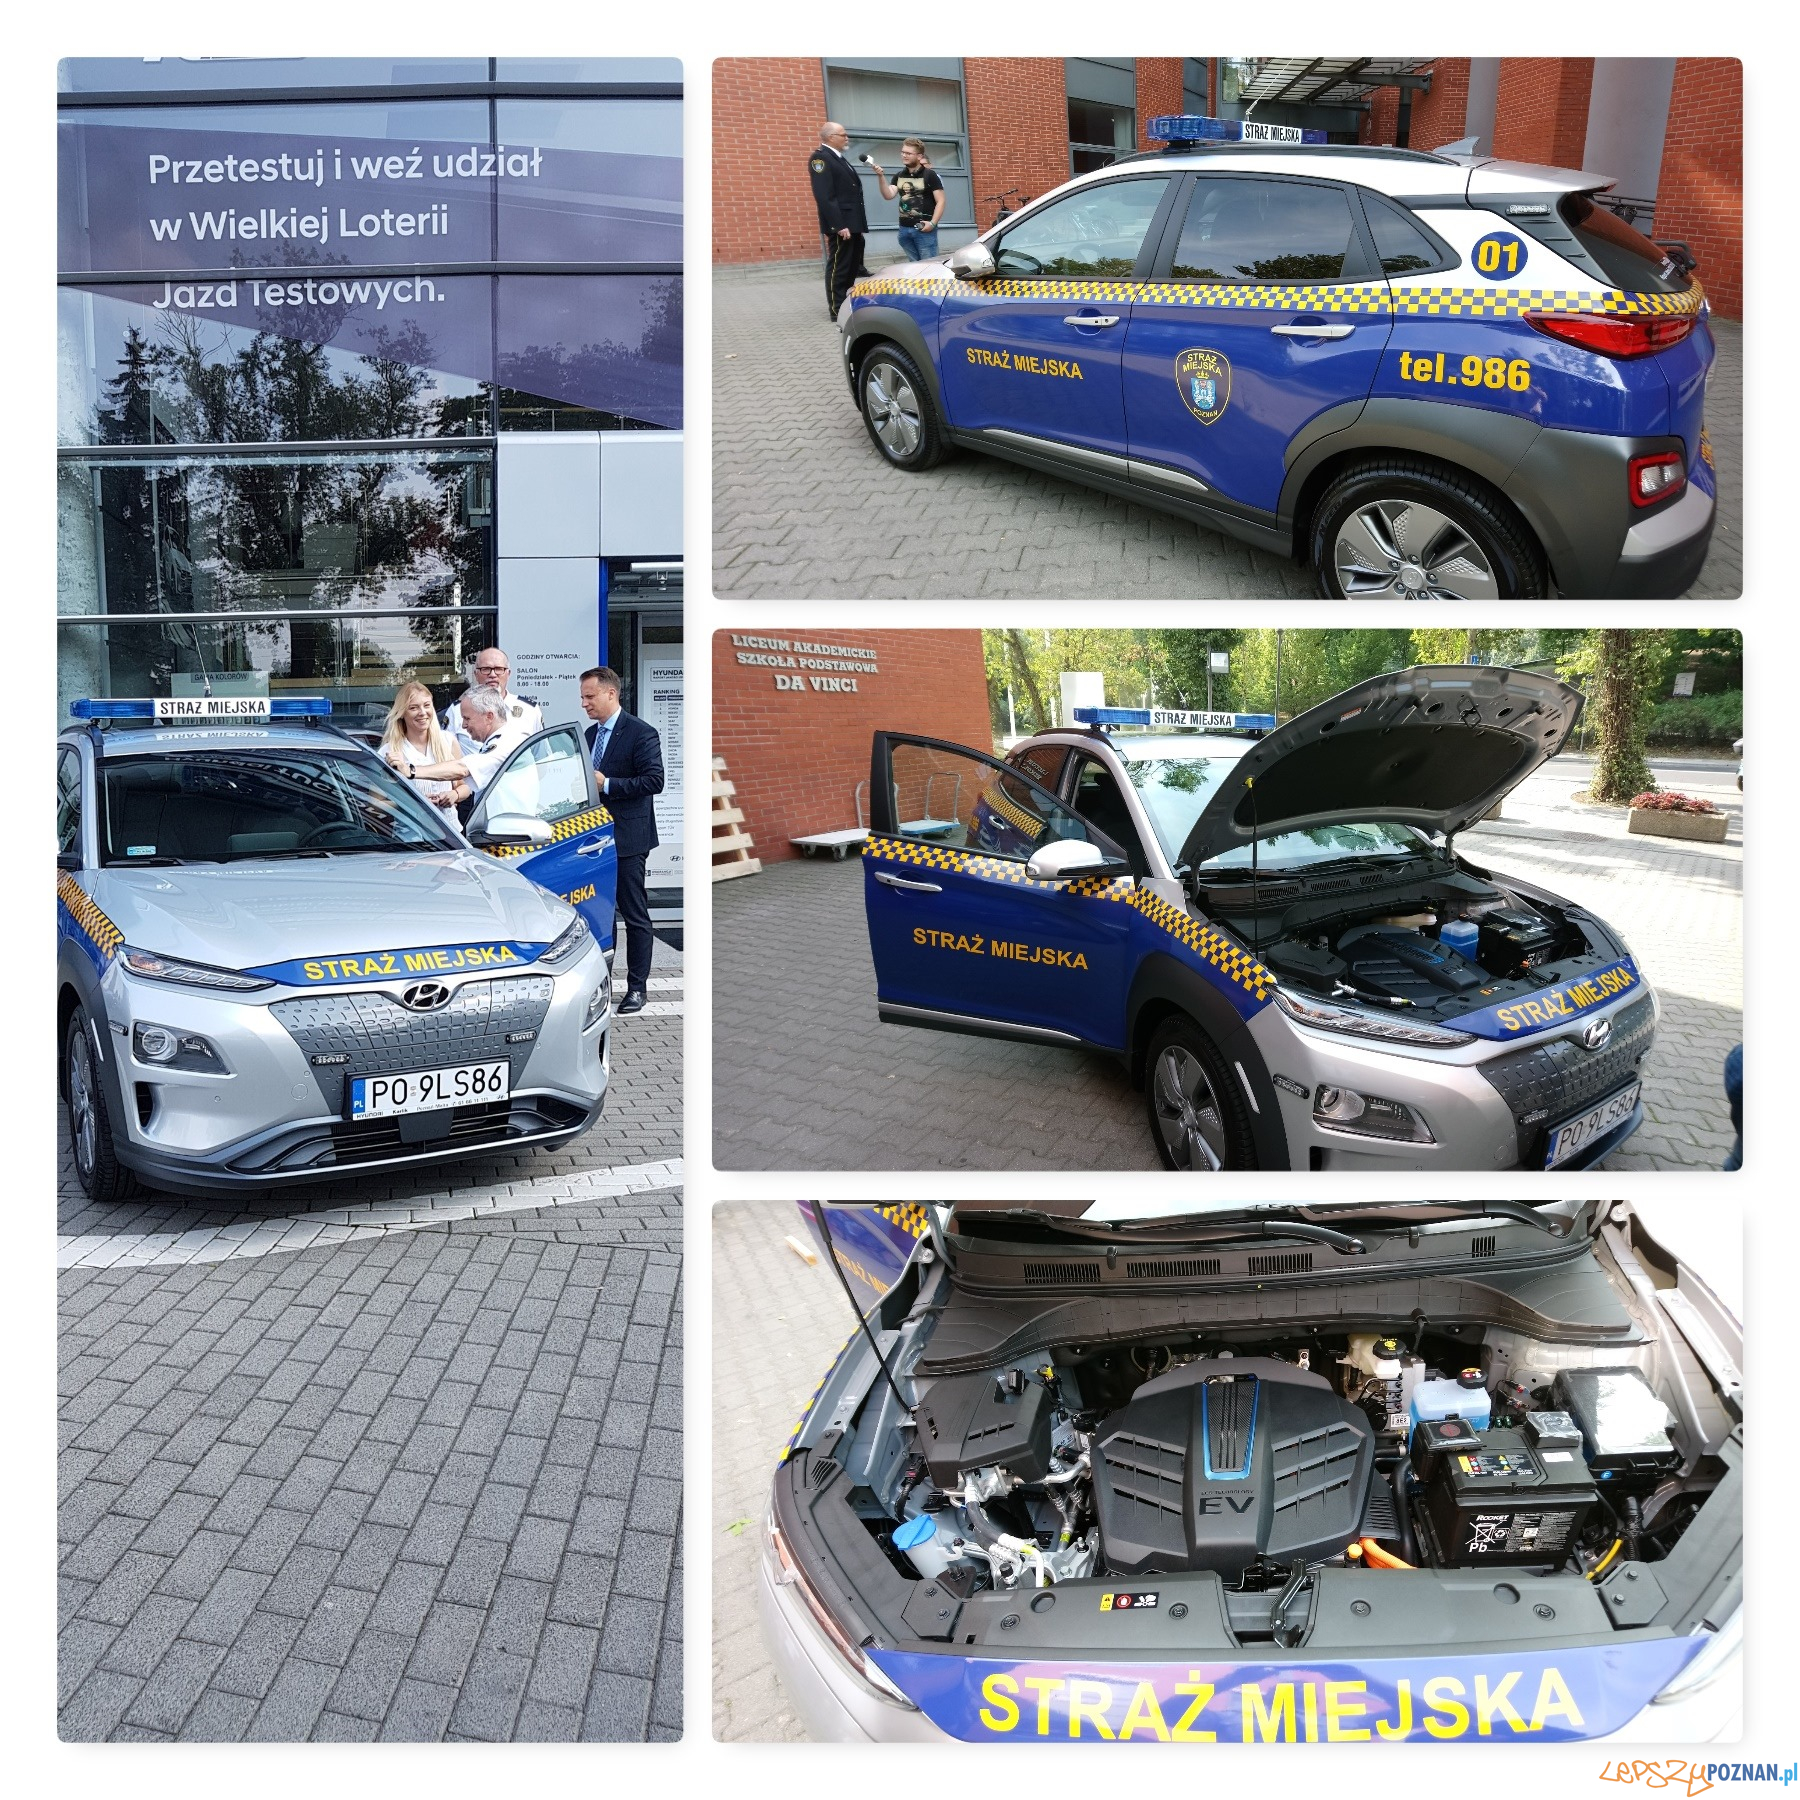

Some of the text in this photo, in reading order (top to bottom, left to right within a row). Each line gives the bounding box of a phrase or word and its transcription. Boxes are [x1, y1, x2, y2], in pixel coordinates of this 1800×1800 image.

[1271, 126, 1300, 142] MIEJSKA
[148, 146, 543, 188] Przetestuj i weź udział
[149, 204, 449, 245] w Wielkiej Loterii
[1477, 240, 1520, 273] 01
[151, 275, 446, 310] Jazd Testowych.
[966, 347, 1083, 380] STRAŻ MIEJSKA
[1182, 361, 1222, 377] MIEJSKA
[730, 633, 878, 660] LICEUM AKADEMICKIE
[736, 651, 879, 673] SZKOŁA PODSTAWOWA
[774, 674, 858, 692] DA VINCI
[207, 700, 266, 714] MIEJSKA
[1189, 713, 1232, 727] MIEJSKA
[303, 945, 519, 980] STRAŻ MIEJSKA
[913, 927, 1089, 970] STRAŻ MIEJSKA
[1496, 966, 1636, 1031] STRAŻ MIEJSKA
[419, 1065, 502, 1103] 9LS86
[353, 1100, 364, 1109] PL
[1586, 1087, 1637, 1139] 9LS86
[1199, 1496, 1255, 1515] EV
[1468, 1542, 1488, 1553] Pb
[979, 1667, 1585, 1743] STRAŻ MIEJSKA
